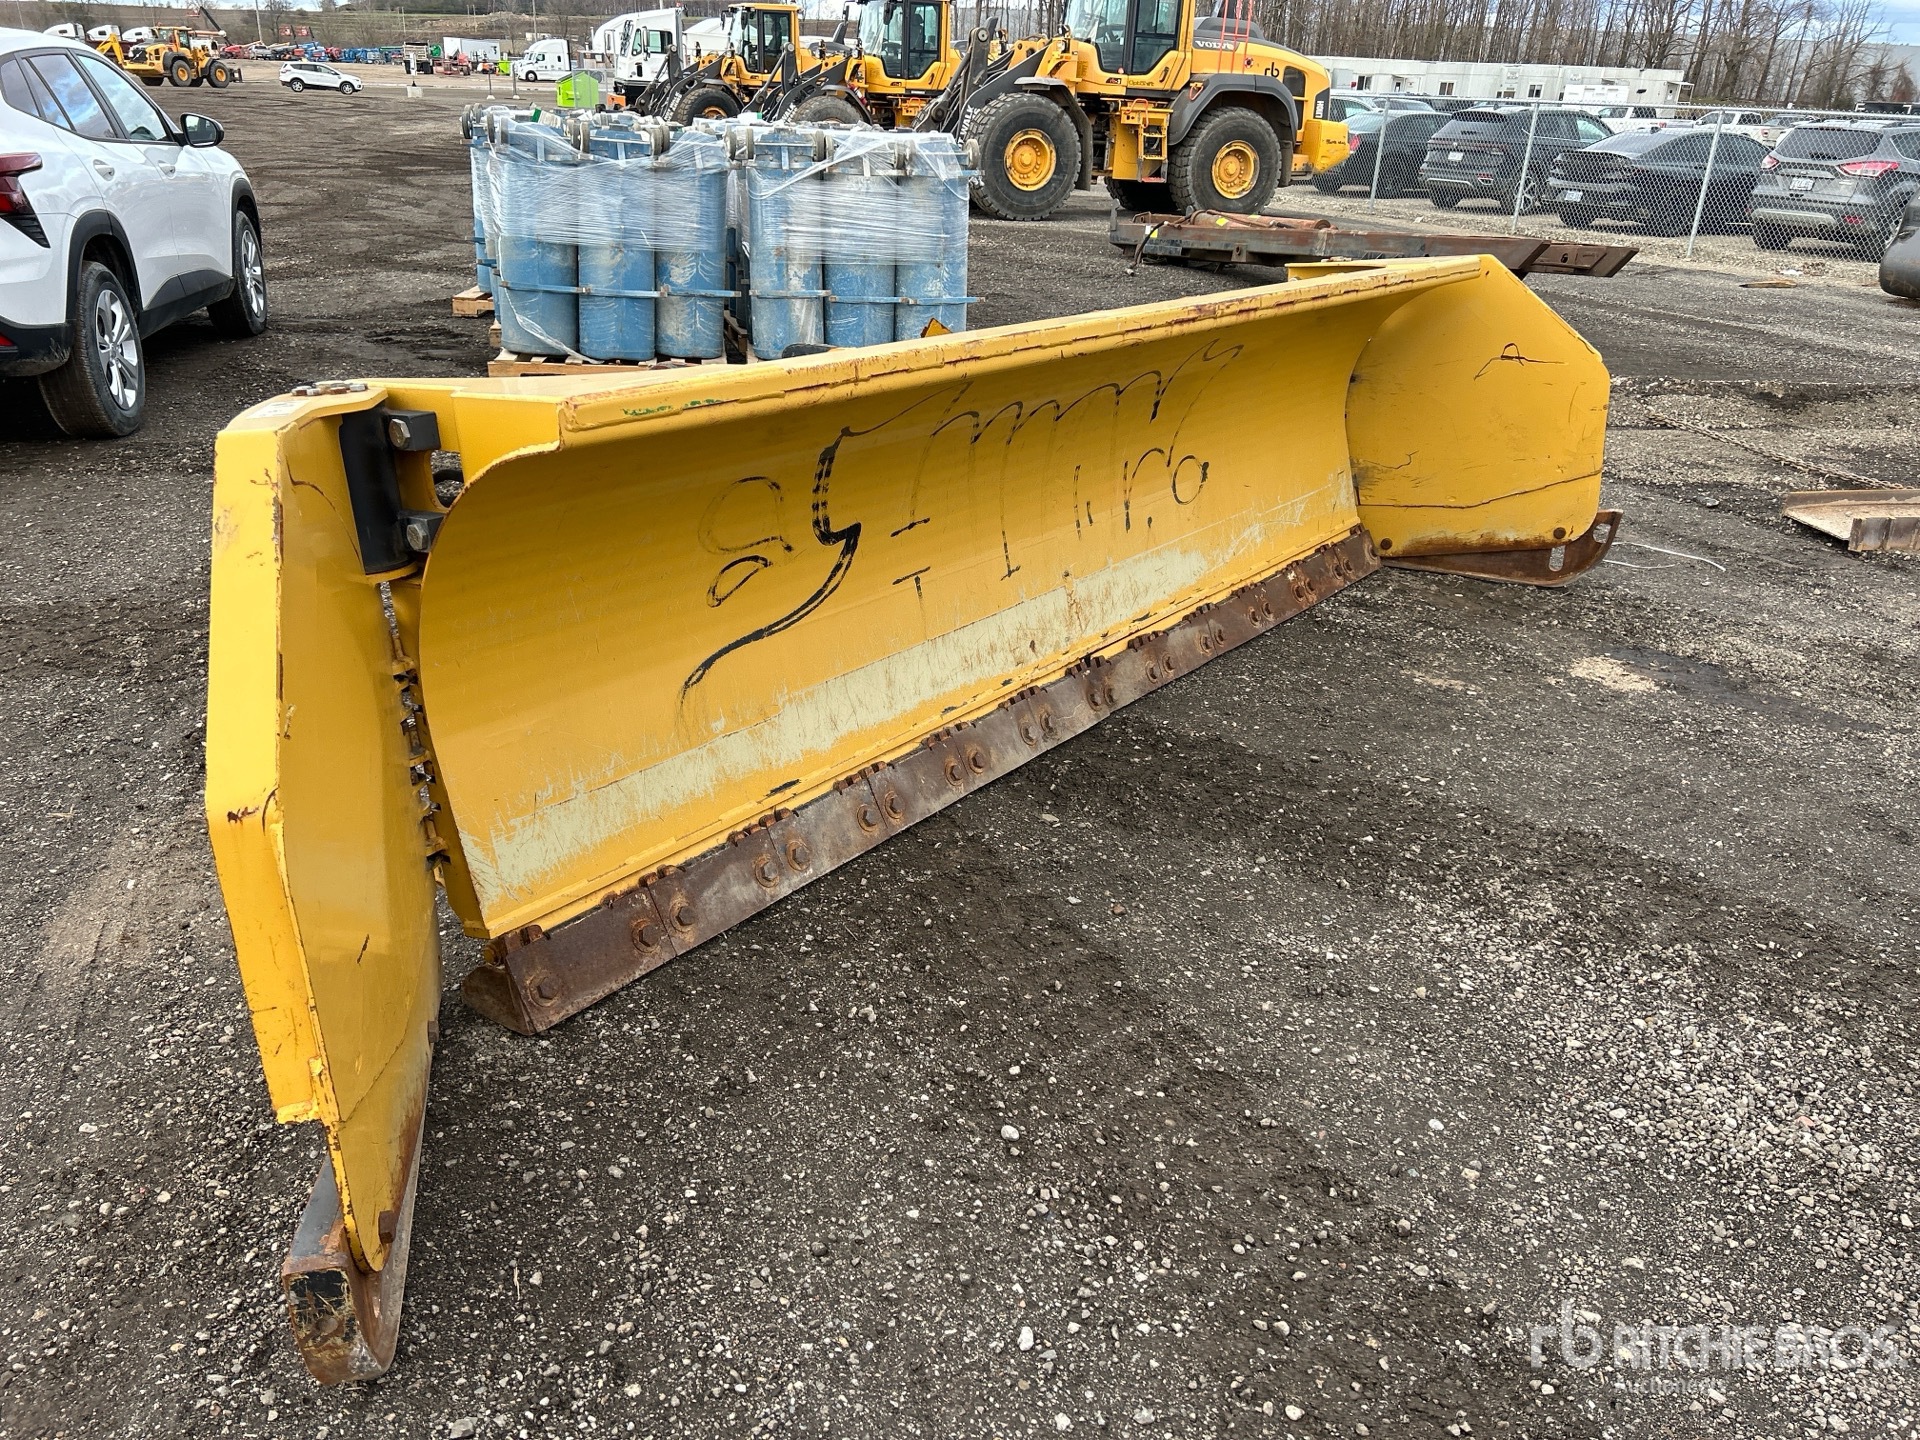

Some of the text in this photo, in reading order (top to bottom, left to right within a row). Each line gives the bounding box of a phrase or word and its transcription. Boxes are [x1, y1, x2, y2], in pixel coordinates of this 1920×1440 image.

[1195, 40, 1235, 50] VOLVO
[1264, 62, 1279, 77] rb
[960, 105, 974, 135] WALK
